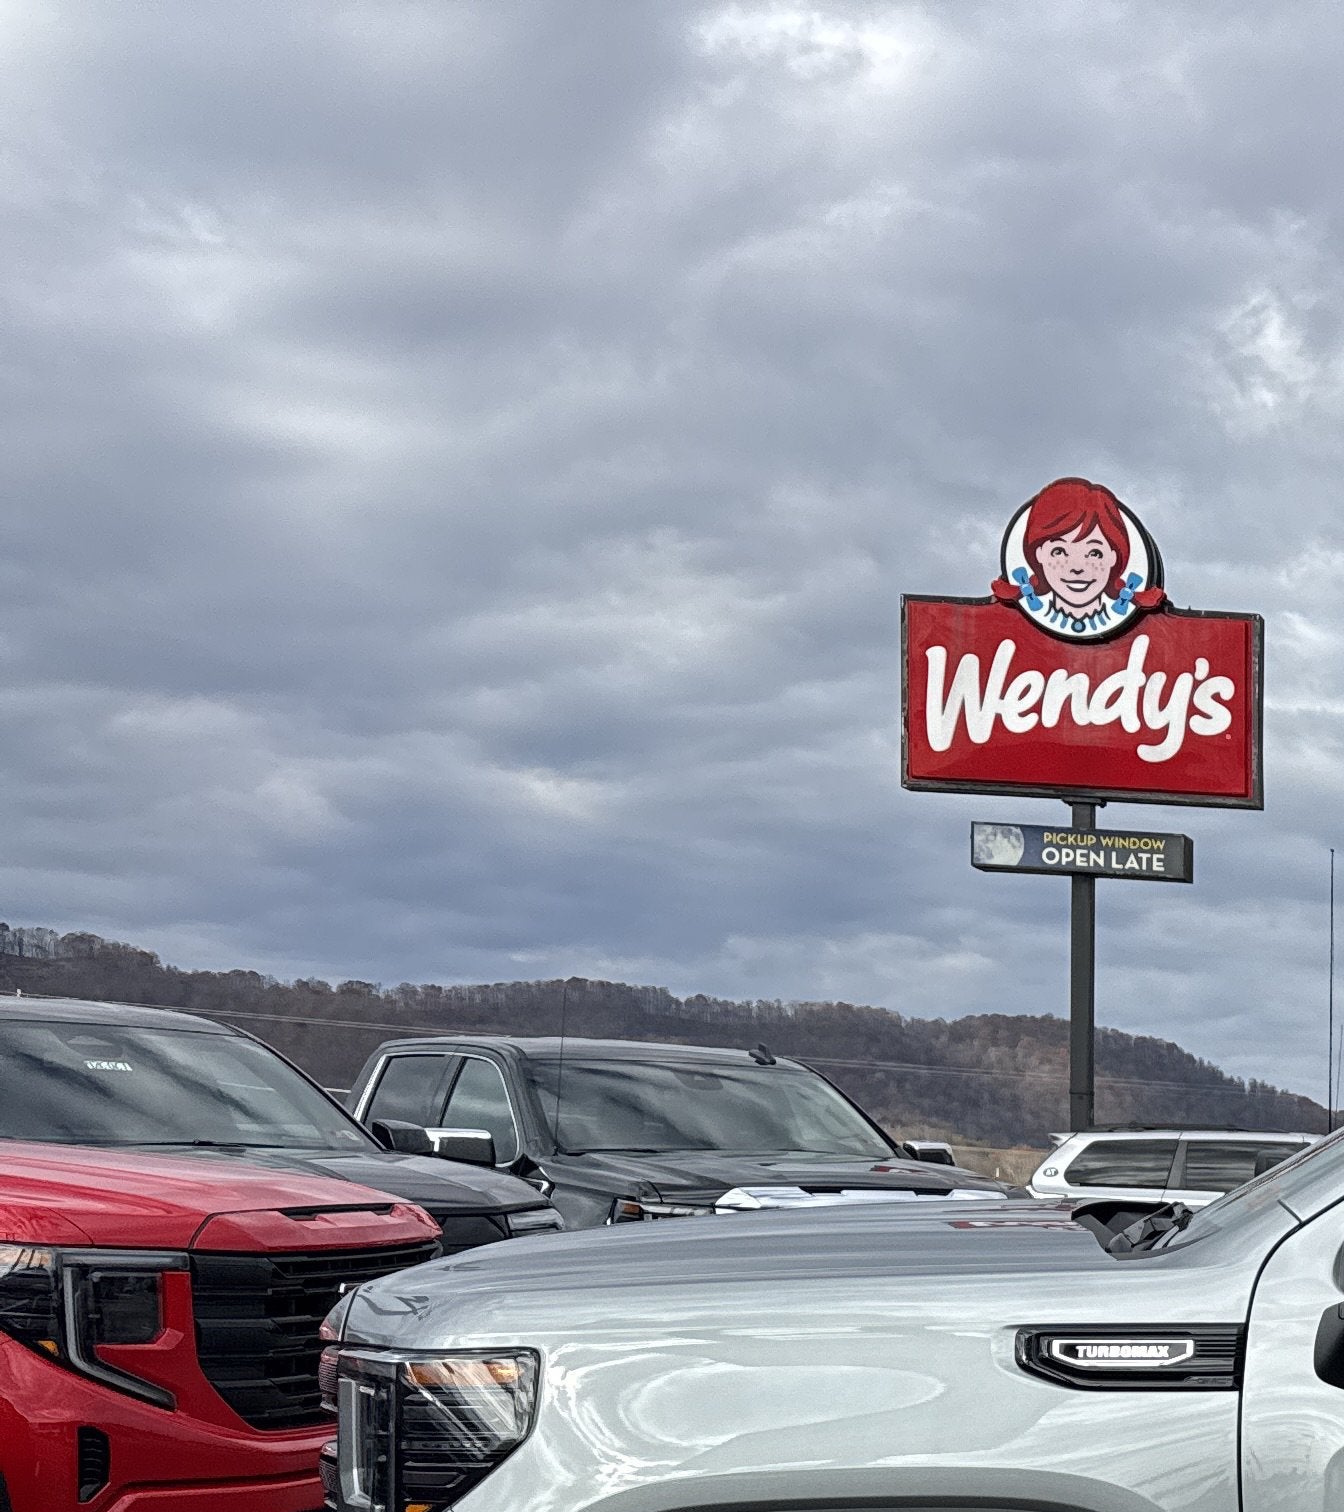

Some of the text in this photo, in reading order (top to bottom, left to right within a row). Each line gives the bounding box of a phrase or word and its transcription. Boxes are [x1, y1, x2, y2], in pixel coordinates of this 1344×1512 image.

[925, 634, 1235, 763] Wendy's
[1043, 831, 1166, 851] PICKUP WINDOW
[1041, 847, 1165, 872] OPEN LATE
[1075, 1345, 1170, 1358] TURBOMAX
